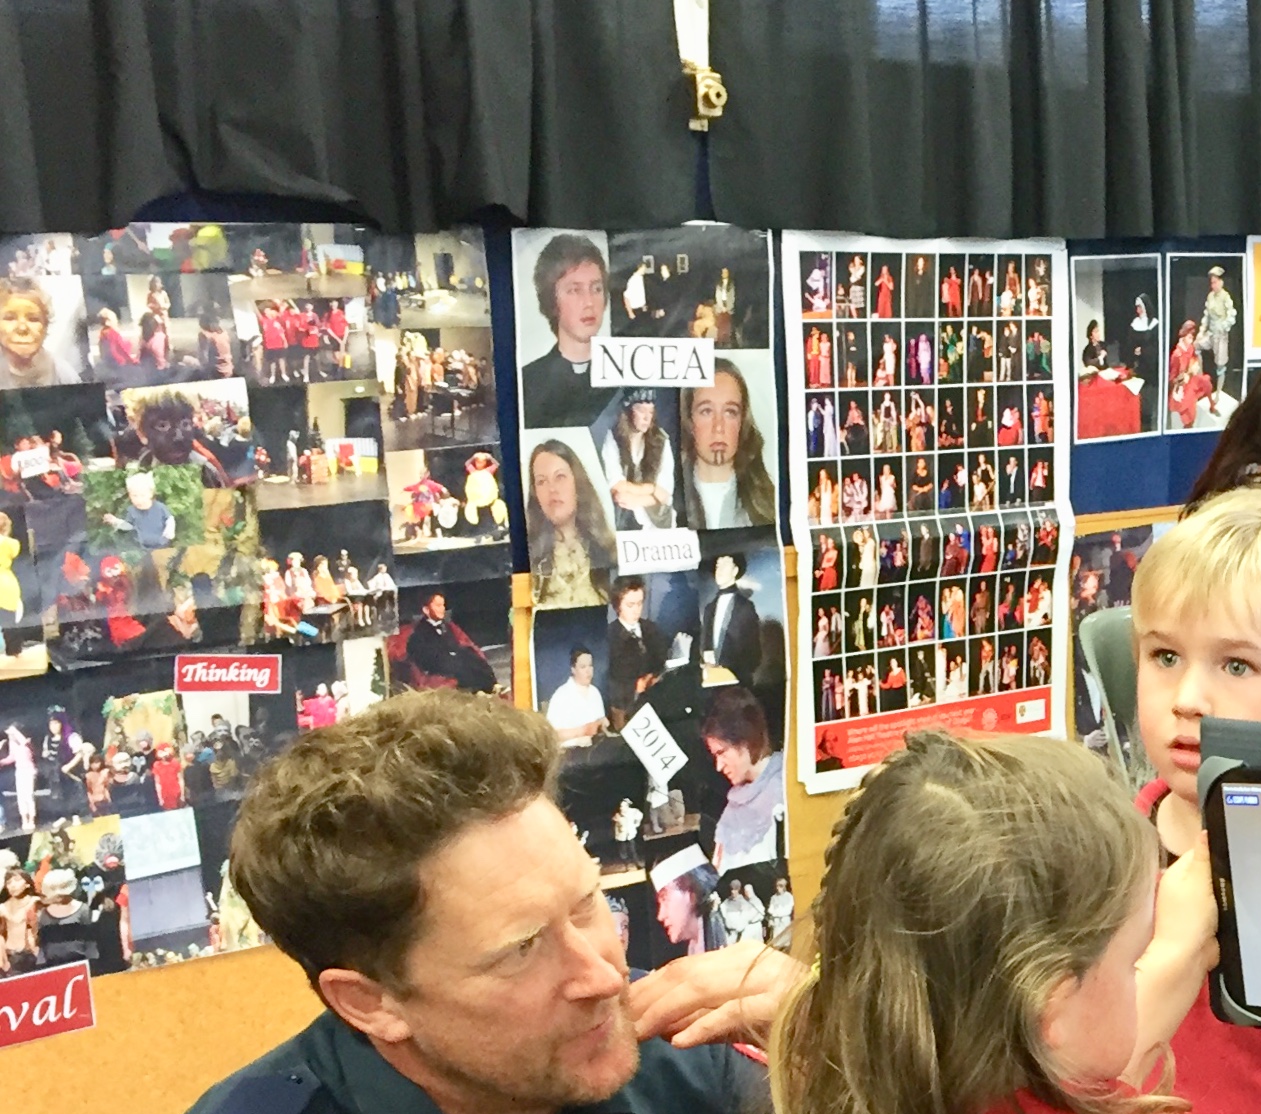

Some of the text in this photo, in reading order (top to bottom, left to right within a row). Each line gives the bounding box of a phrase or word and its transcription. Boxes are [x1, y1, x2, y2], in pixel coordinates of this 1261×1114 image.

[599, 344, 708, 380] NCEA
[623, 540, 694, 563] Drama
[181, 661, 271, 688] Thinking
[632, 716, 677, 771] 2014
